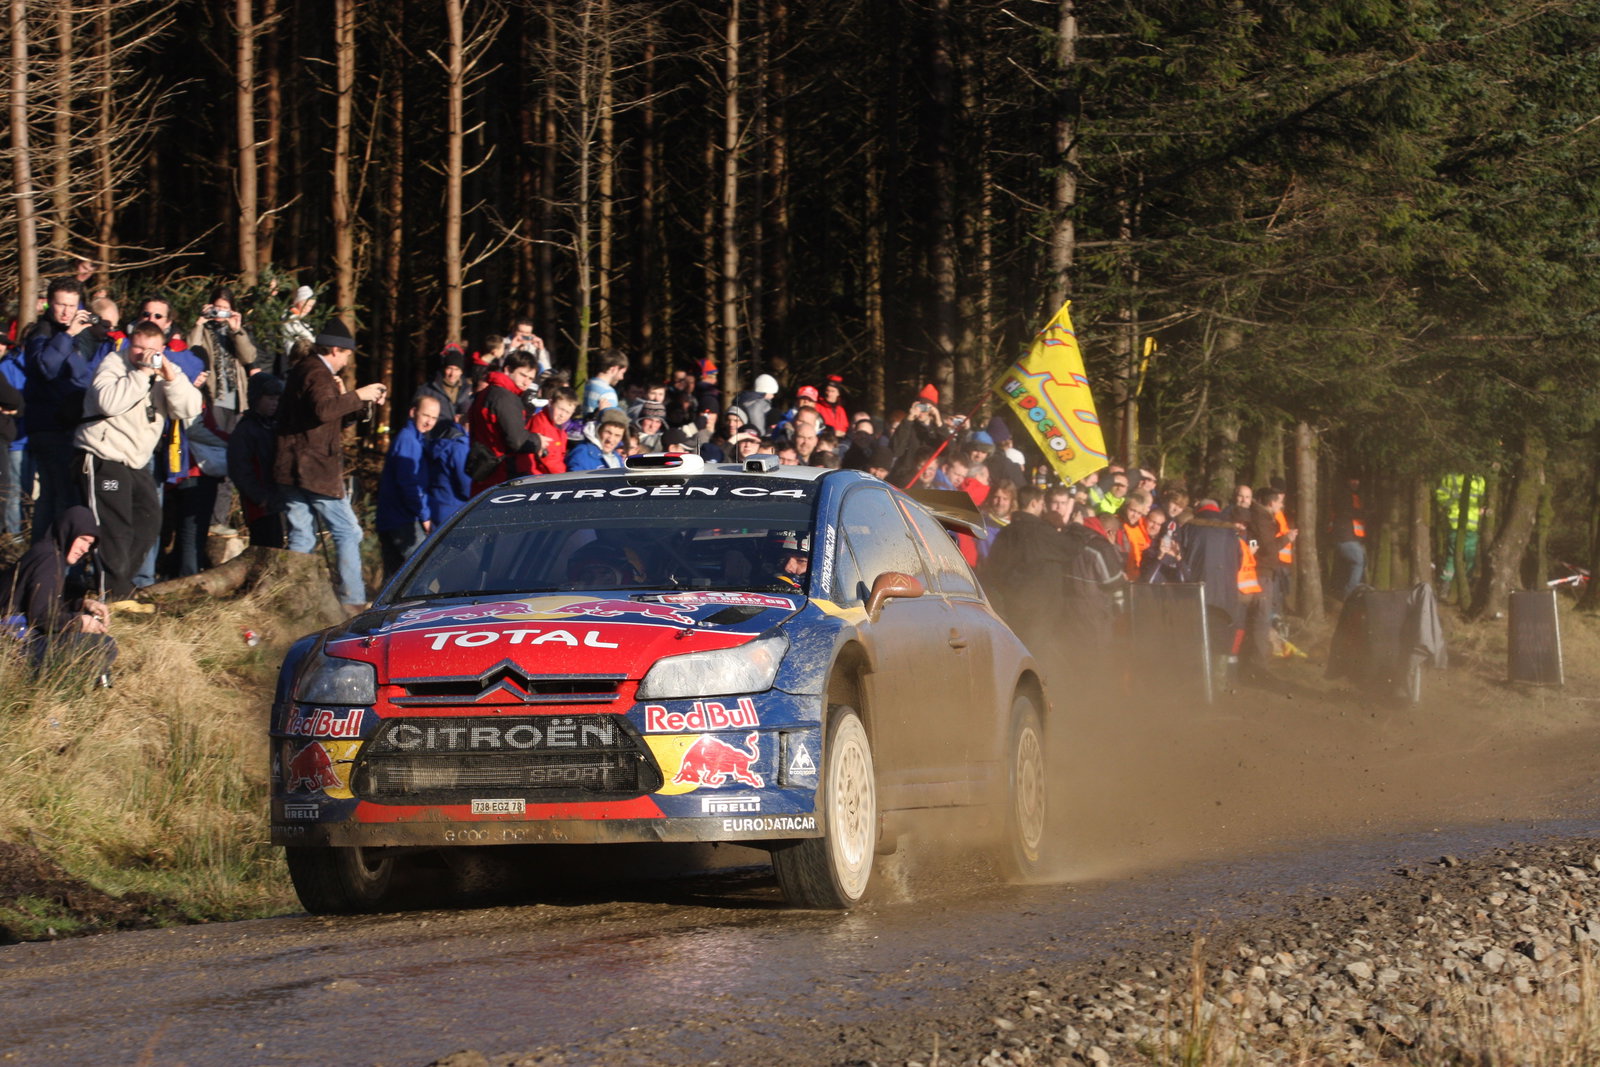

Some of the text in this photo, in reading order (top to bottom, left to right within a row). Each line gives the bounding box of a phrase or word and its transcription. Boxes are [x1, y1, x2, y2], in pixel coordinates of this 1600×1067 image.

[1018, 395, 1076, 463] DOCTOR
[491, 485, 806, 503] CITROËN C4
[424, 630, 618, 650] TOTAL
[285, 708, 364, 737] Red Bull
[645, 698, 759, 732] Red Bull
[387, 719, 613, 749] CITROËN
[530, 768, 609, 782] SPORT
[285, 804, 319, 818] PIRELLI
[475, 804, 490, 812] 738
[702, 797, 760, 812] PIRELLI
[724, 817, 815, 831] EURODATACAR
